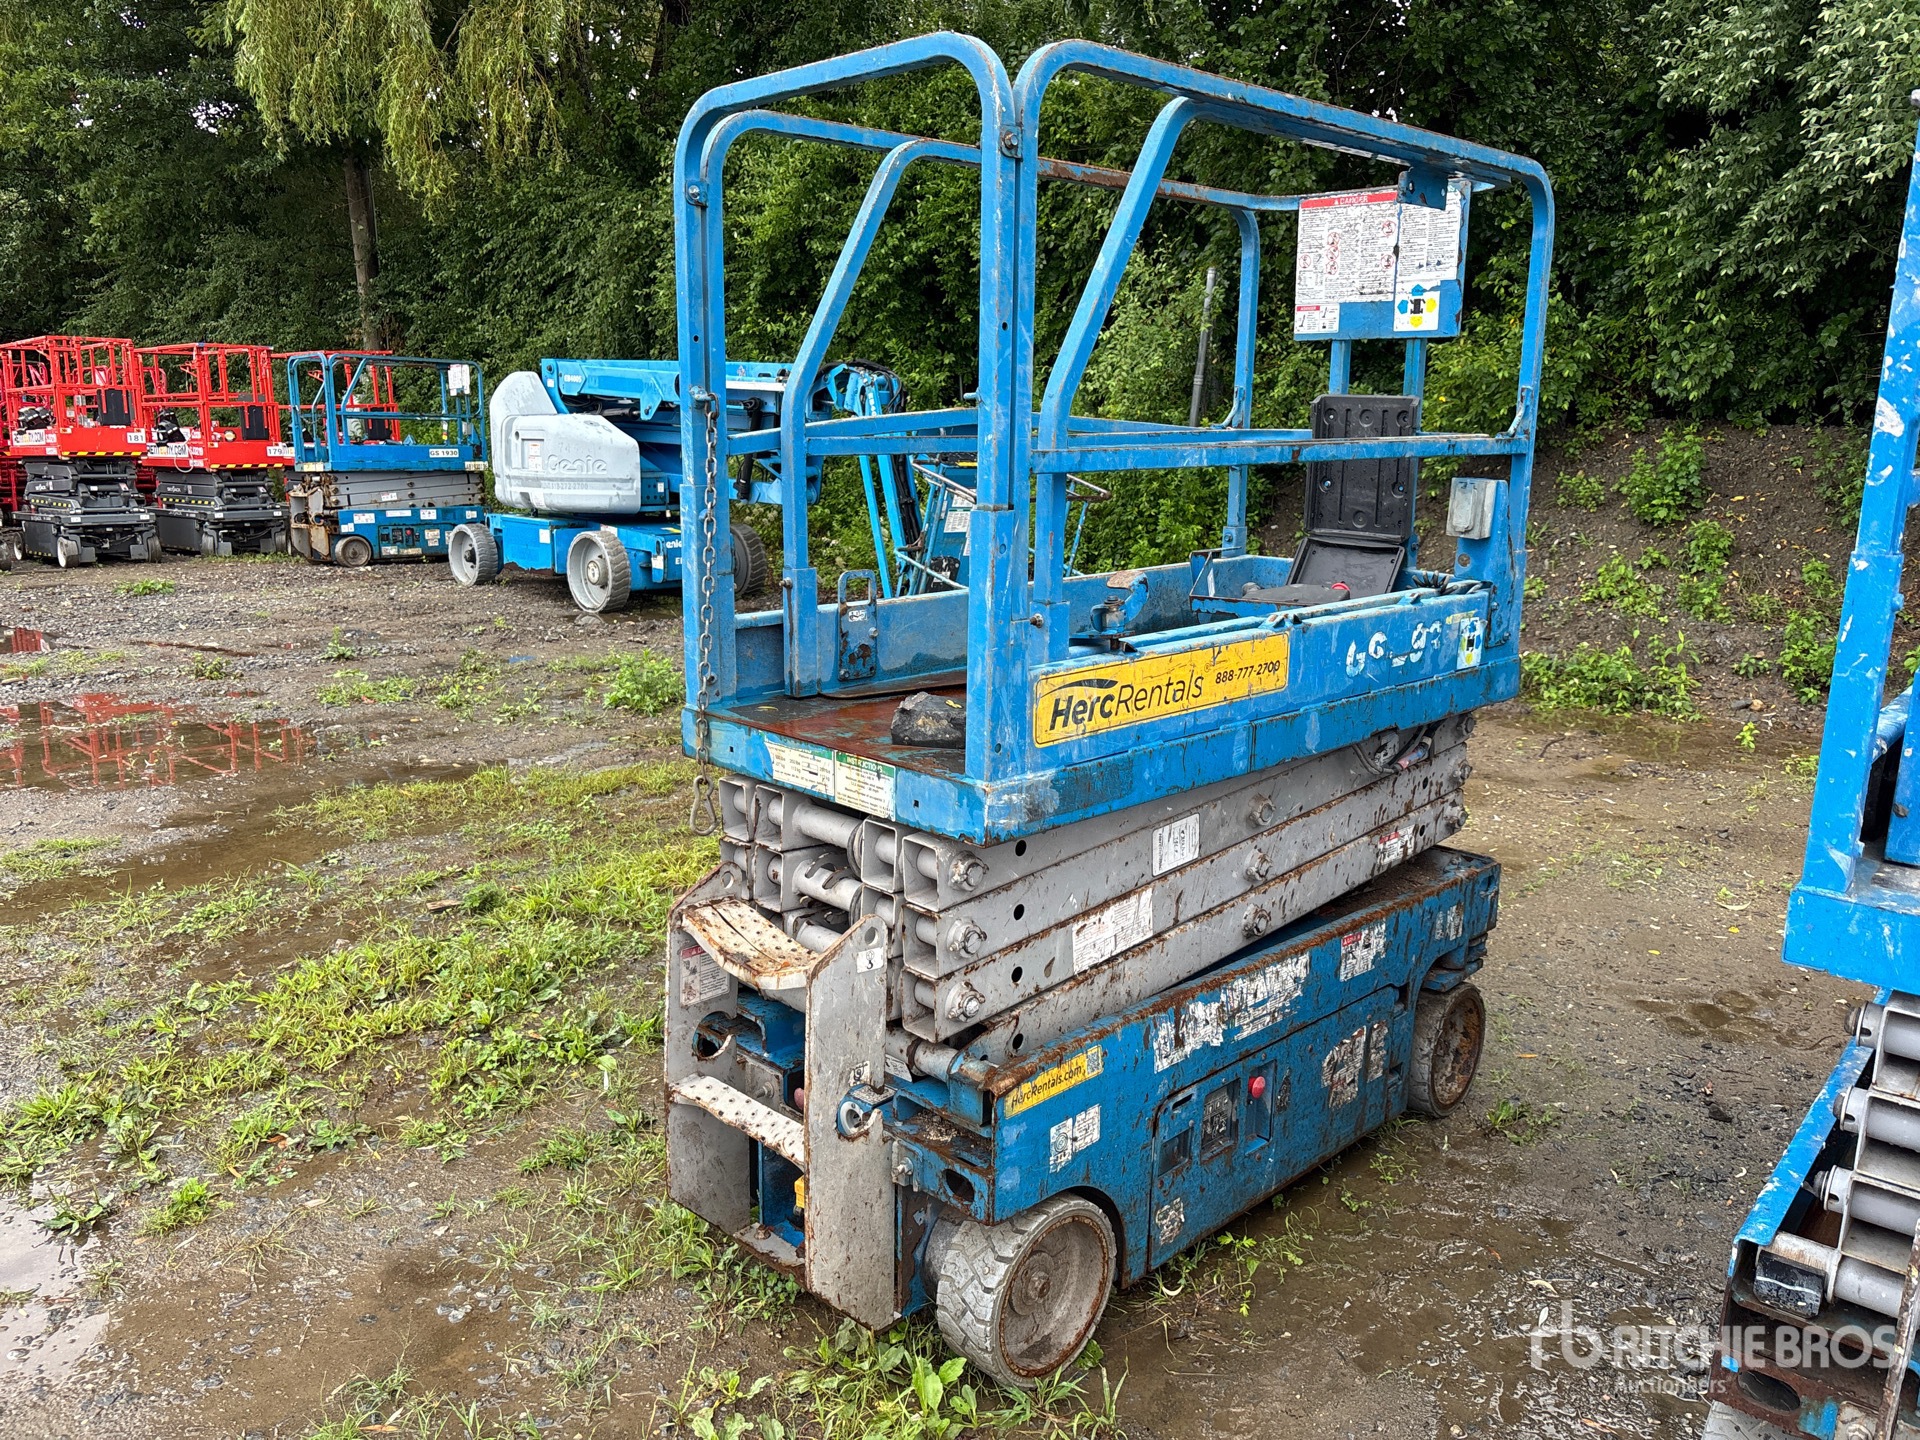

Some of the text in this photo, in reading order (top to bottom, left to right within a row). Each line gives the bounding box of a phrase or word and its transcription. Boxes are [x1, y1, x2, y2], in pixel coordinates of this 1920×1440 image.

[128, 434, 144, 442] 181
[547, 453, 607, 475] Genie
[1215, 659, 1281, 684] 888-777-2700
[1050, 669, 1204, 731] HercRentals
[1011, 1065, 1082, 1112] HercRentals.com
